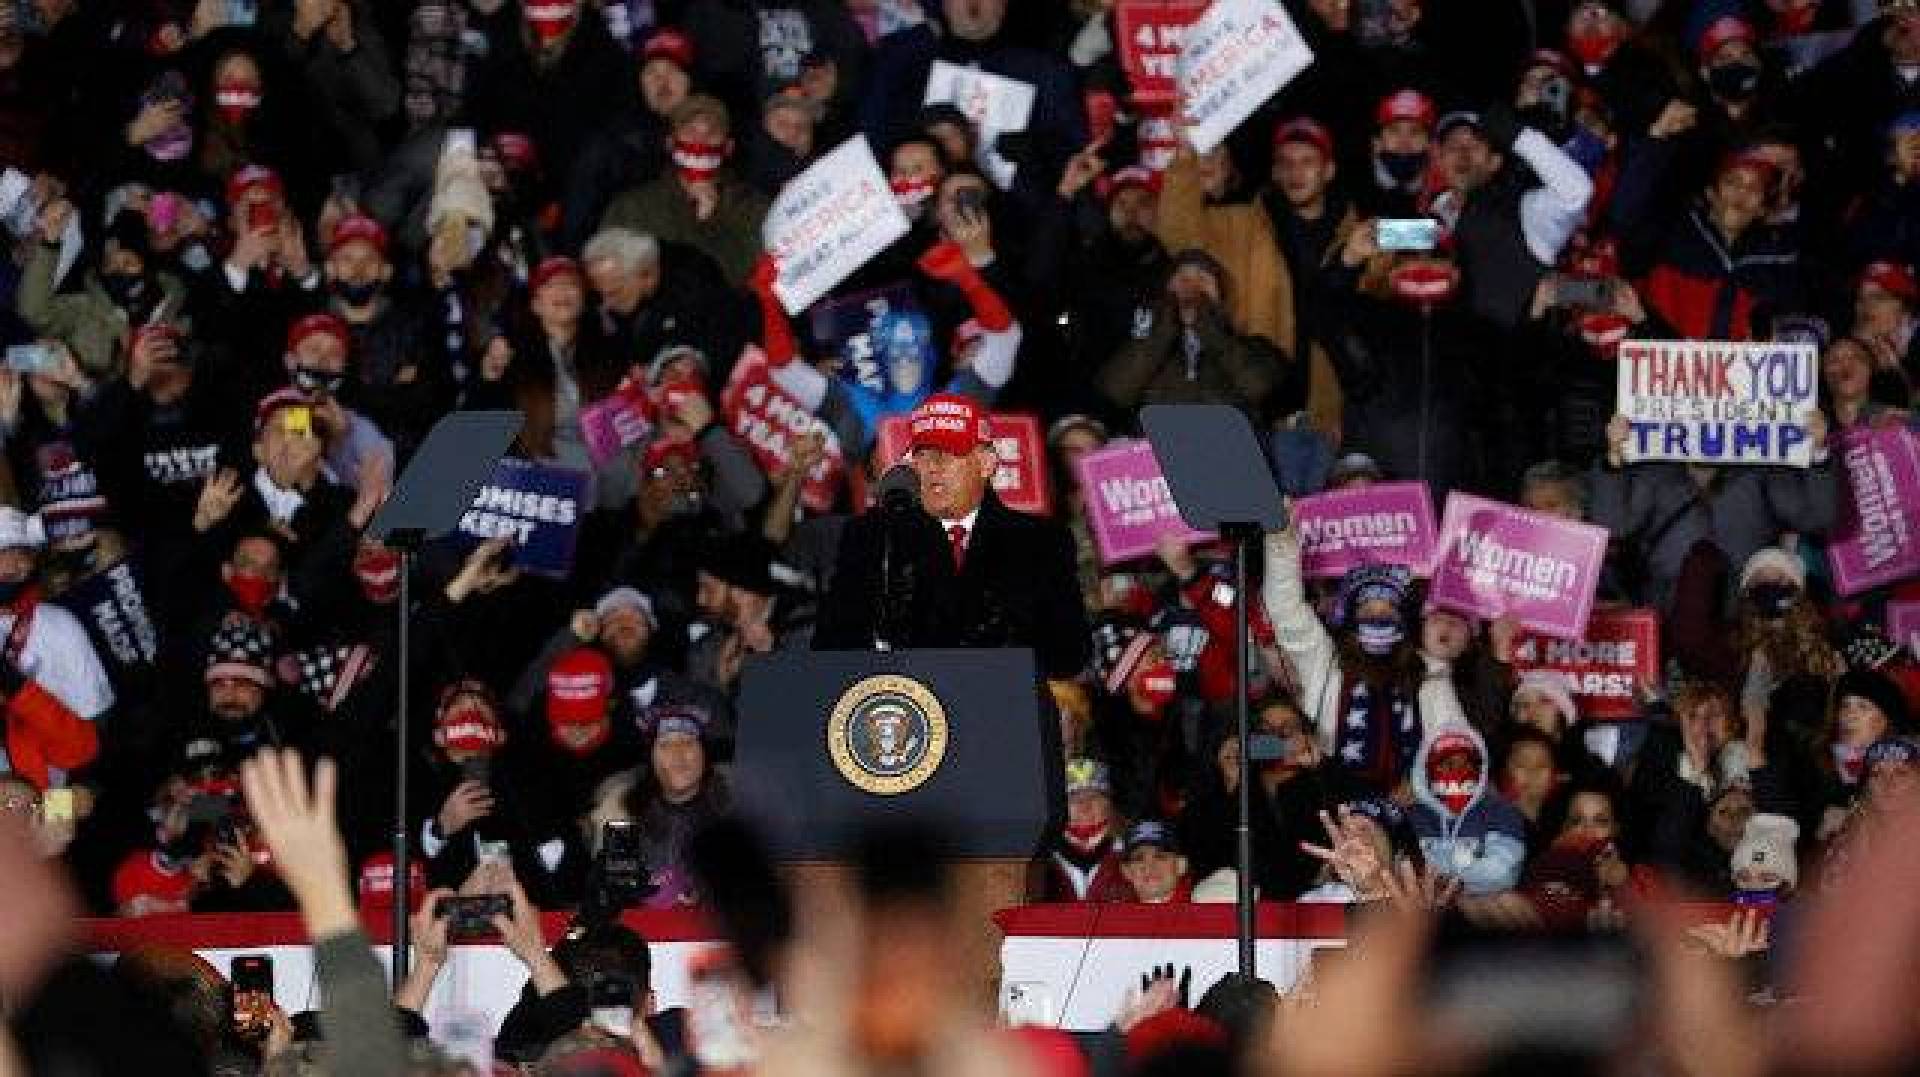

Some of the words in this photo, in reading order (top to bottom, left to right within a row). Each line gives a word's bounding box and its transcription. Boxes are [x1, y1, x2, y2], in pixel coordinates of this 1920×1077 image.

[1624, 347, 1735, 400] THANK
[1743, 349, 1814, 403] YOU
[1632, 396, 1797, 422] PRESIDENT
[1629, 420, 1808, 459] TRUMP
[457, 509, 537, 547] KEPT
[1298, 511, 1419, 549] Women
[1458, 526, 1578, 590] Women
